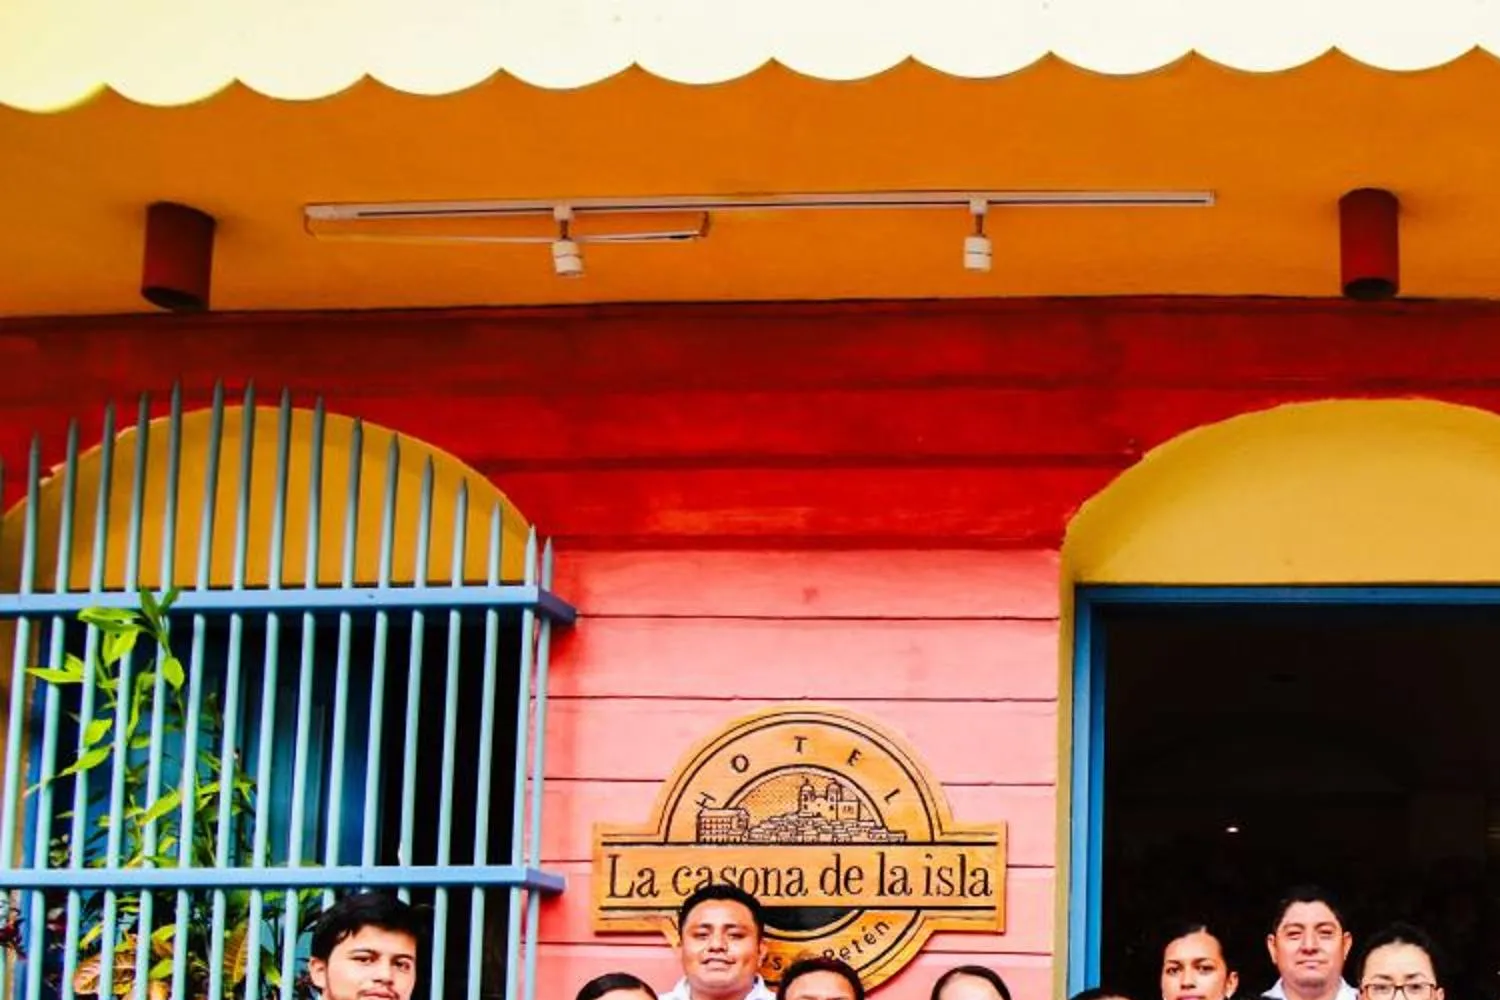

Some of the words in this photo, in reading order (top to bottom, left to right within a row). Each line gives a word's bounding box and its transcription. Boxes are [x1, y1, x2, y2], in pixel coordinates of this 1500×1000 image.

[695, 735, 901, 810] HOTEL
[606, 853, 660, 898] La
[671, 864, 809, 898] casona
[819, 852, 864, 897] de
[876, 851, 913, 897] la
[922, 852, 993, 898] isla
